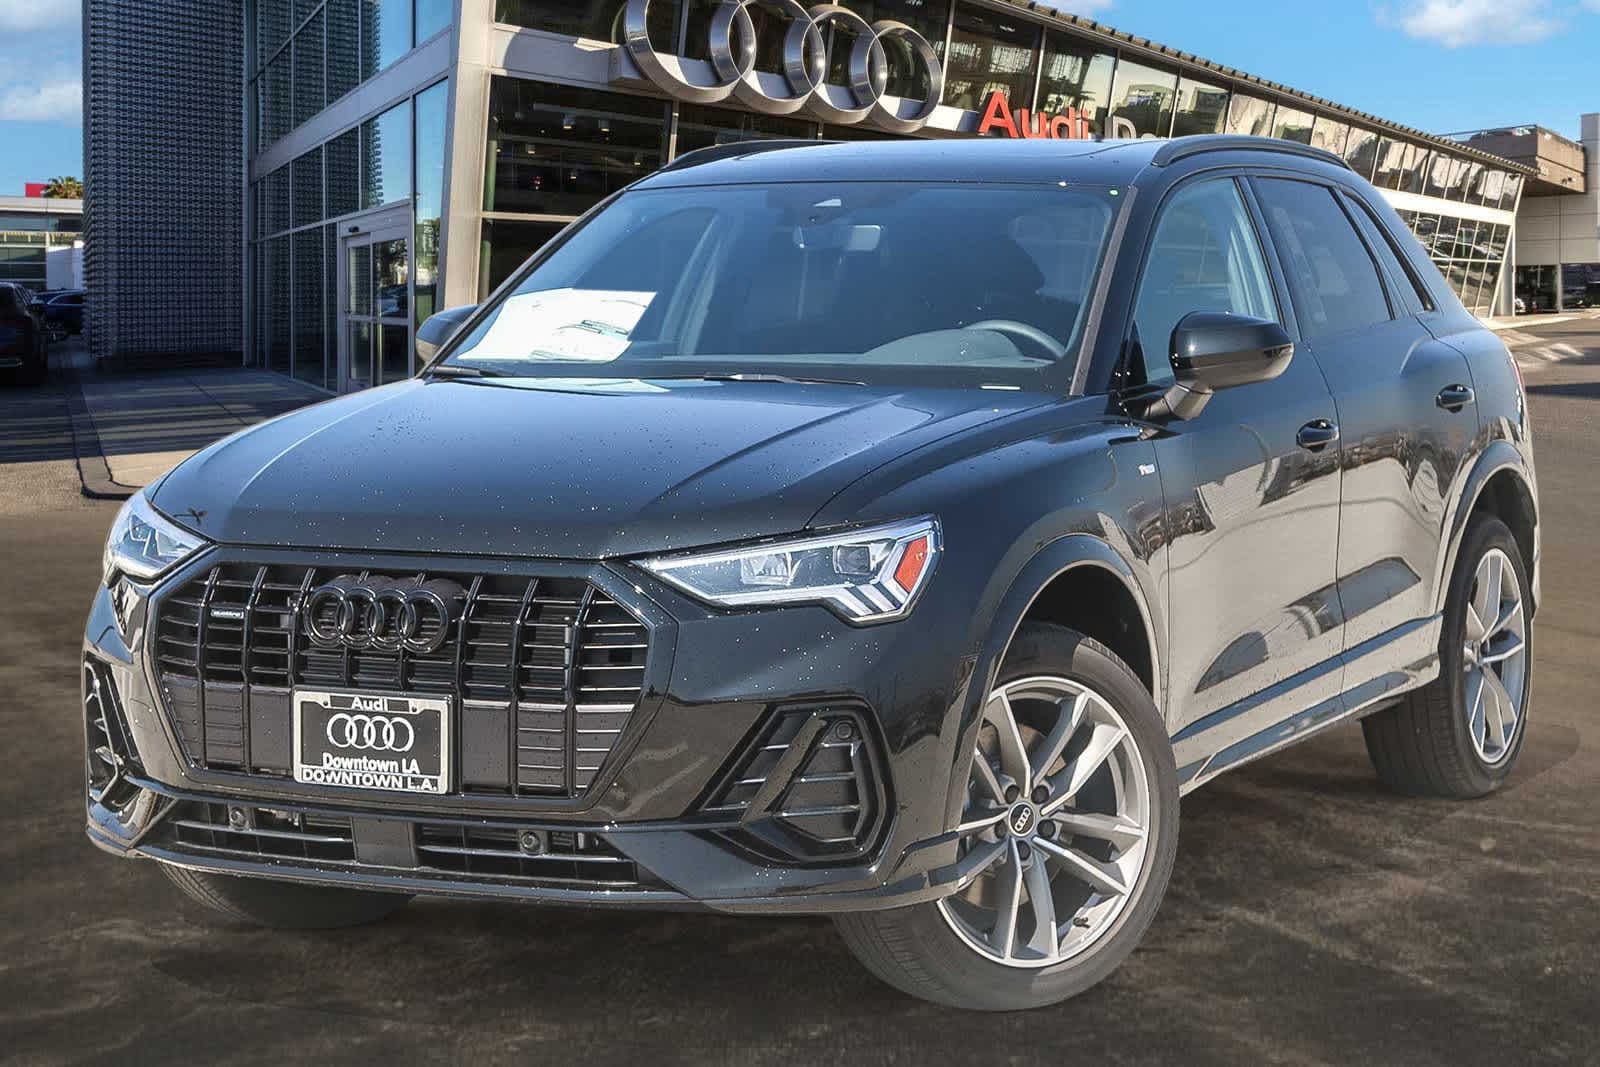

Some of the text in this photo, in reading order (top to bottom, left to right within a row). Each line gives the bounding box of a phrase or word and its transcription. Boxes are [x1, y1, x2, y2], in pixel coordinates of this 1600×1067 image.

[979, 91, 1089, 139] Audi
[351, 697, 388, 711] Audi
[322, 752, 421, 774] Downtown LA
[302, 768, 437, 791] DOWNTOWN L.A.
